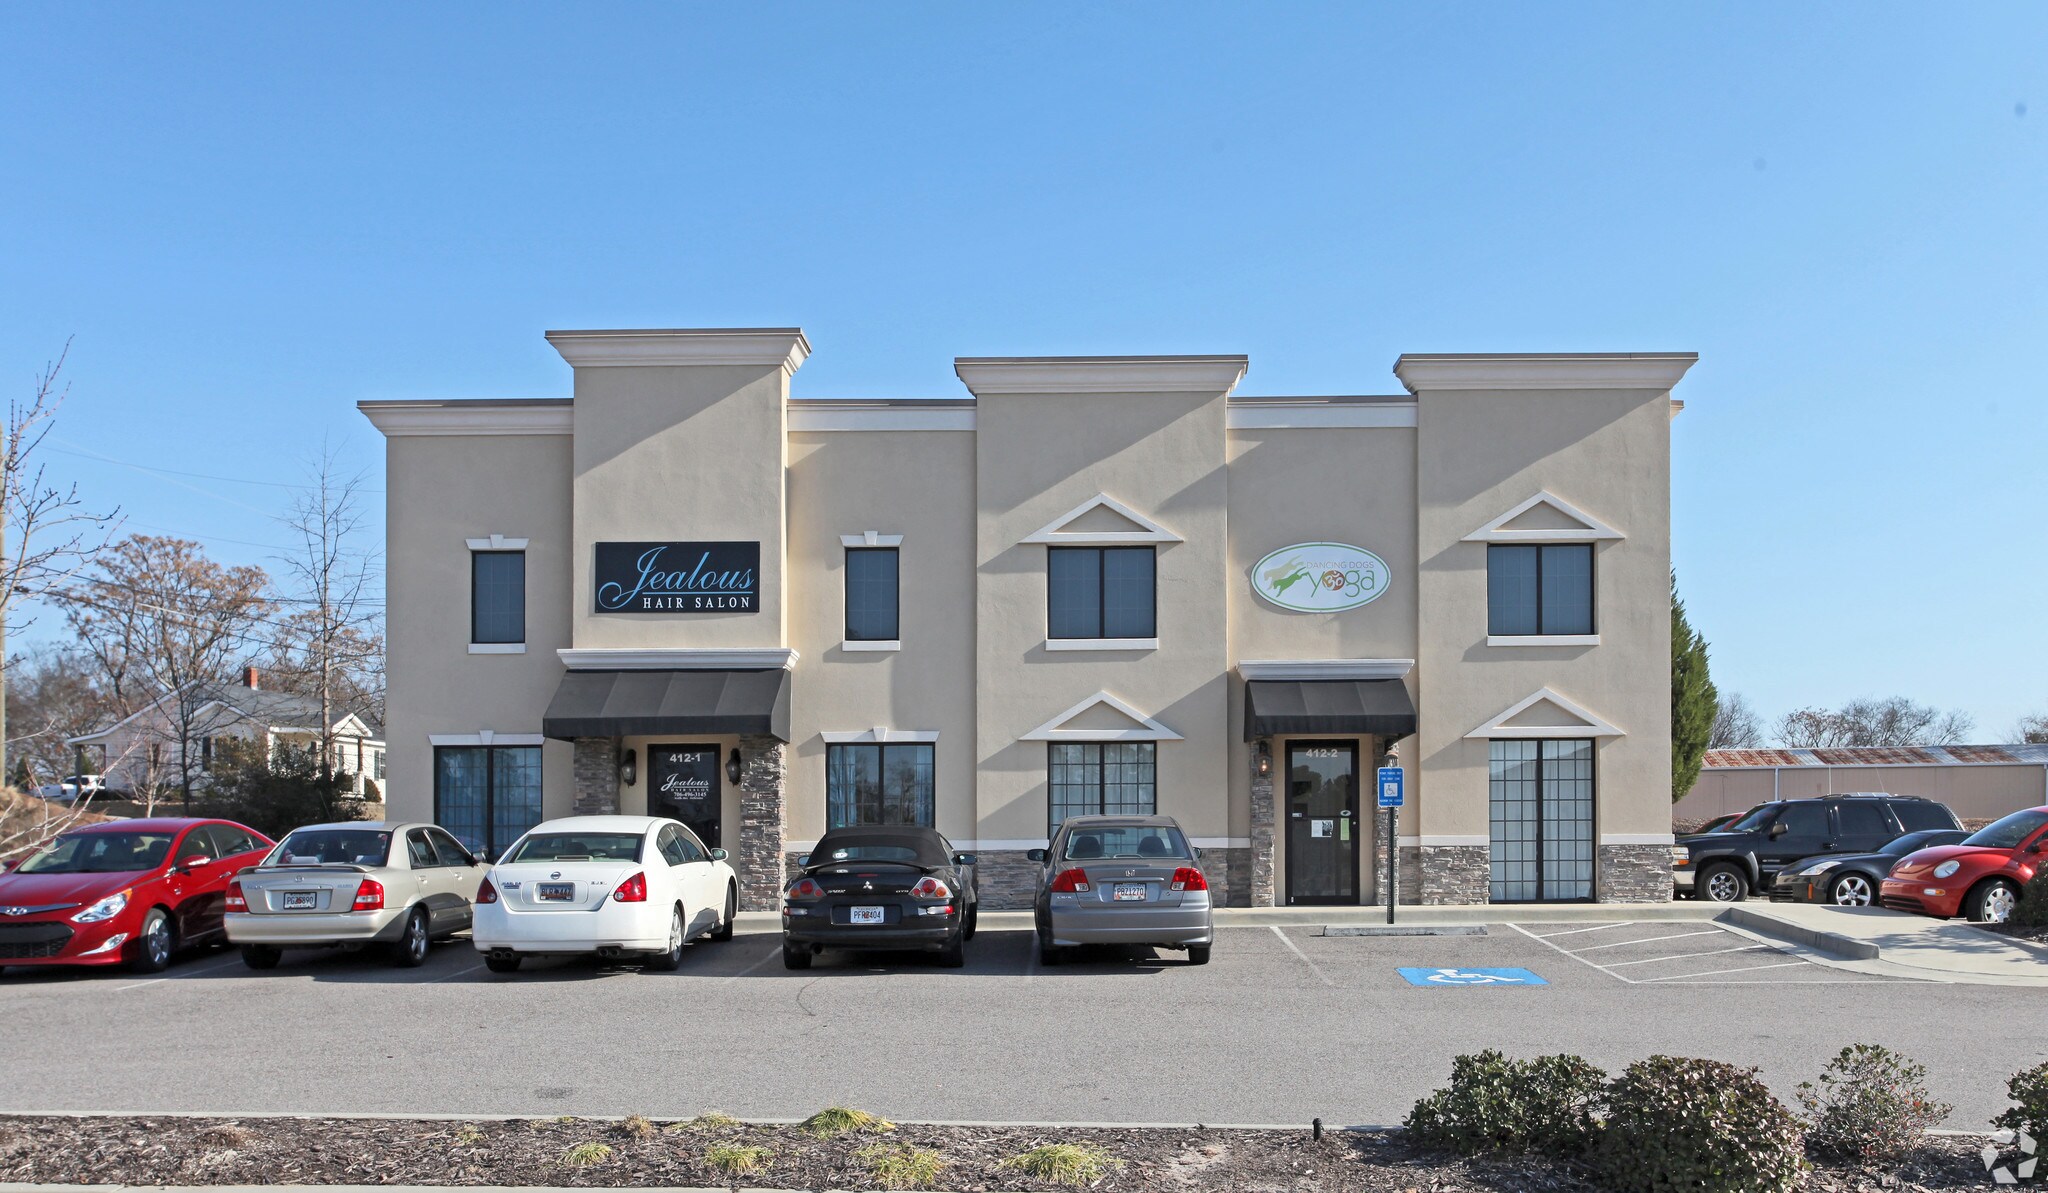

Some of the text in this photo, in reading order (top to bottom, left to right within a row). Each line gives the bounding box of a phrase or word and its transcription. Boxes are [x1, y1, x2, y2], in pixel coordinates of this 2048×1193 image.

[1306, 561, 1375, 569] DANCING DOGS
[598, 545, 755, 610] Jealous
[1306, 569, 1375, 598] yoga
[642, 596, 750, 609] HAIR SALON
[669, 753, 701, 762] 412-1
[1305, 748, 1339, 758] 412-2
[661, 773, 709, 791] Jealous
